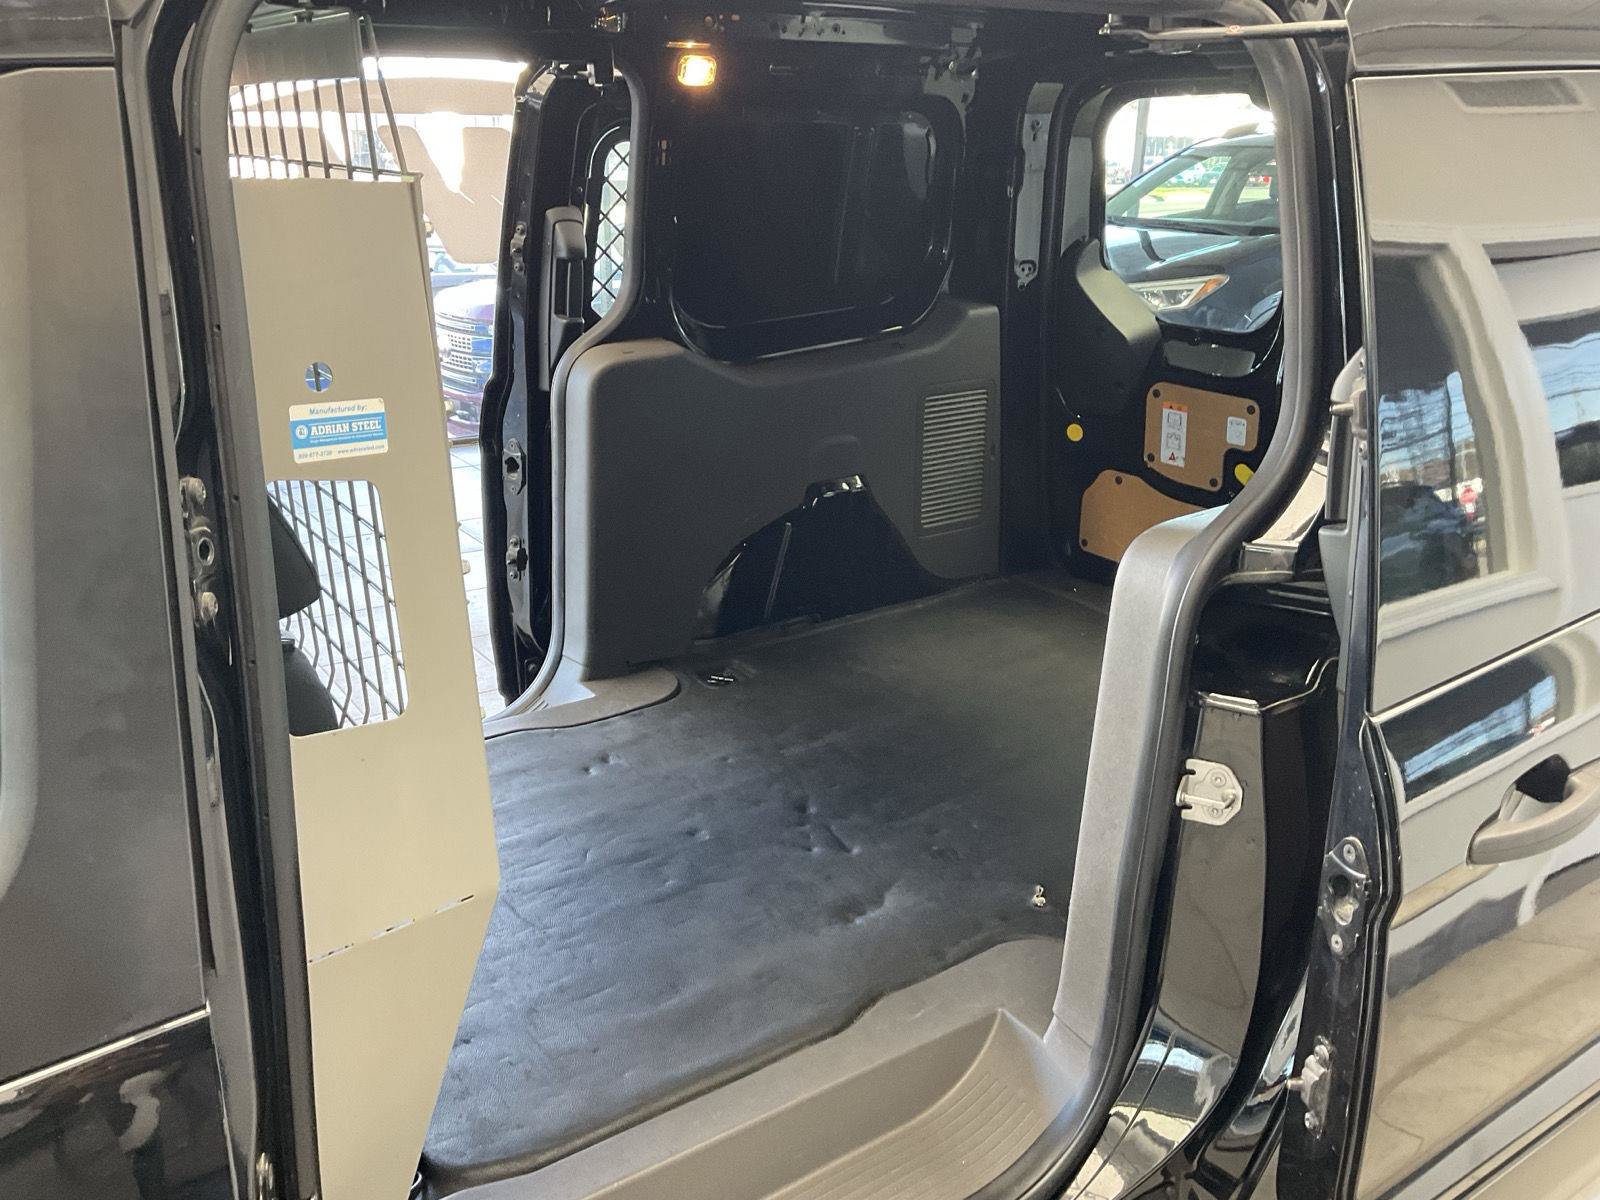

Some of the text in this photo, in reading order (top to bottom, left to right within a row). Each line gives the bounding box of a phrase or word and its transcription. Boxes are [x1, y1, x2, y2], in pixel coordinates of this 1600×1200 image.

[309, 405, 355, 415] Manufactured
[310, 419, 382, 436] ADRIAN STEEL
